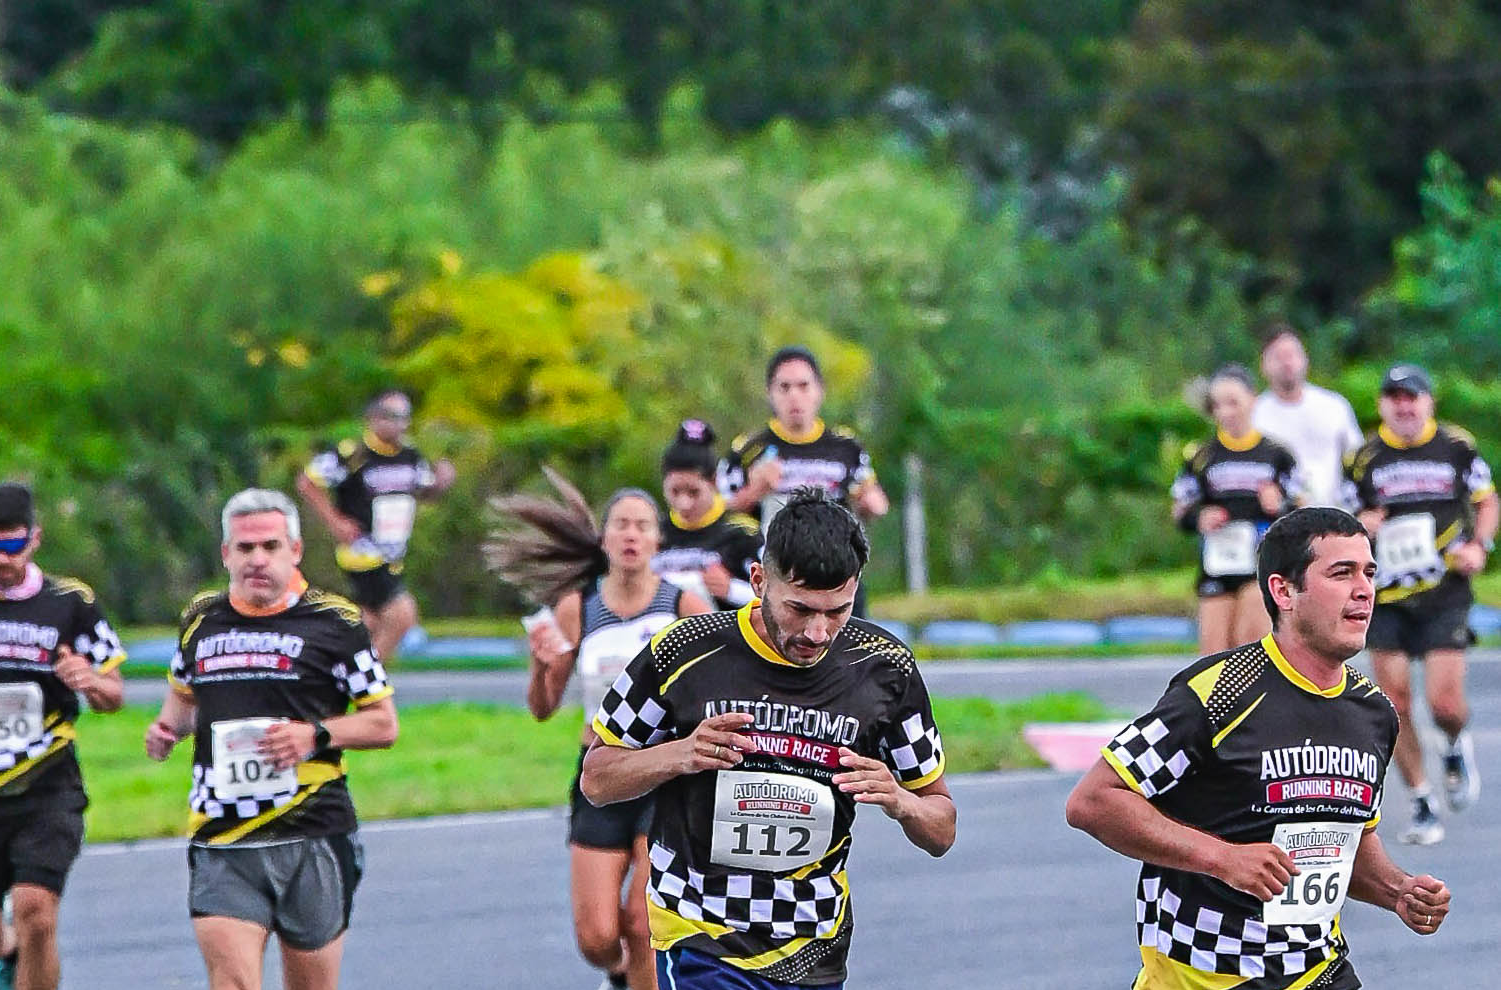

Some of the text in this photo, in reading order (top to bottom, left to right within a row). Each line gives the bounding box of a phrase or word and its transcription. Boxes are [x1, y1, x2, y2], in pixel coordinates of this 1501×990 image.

[733, 736, 830, 763] NNING RACE
[1260, 739, 1377, 784] AUTÓDROMO
[734, 779, 818, 804] AUTÓDROMO
[1282, 780, 1364, 802] RUNNING RACE
[746, 801, 802, 812] RUNNING RACE
[1264, 805, 1293, 814] Carrera
[731, 823, 811, 857] 112
[1286, 828, 1348, 849] AUTÓDROMO
[1281, 872, 1340, 905] 166
